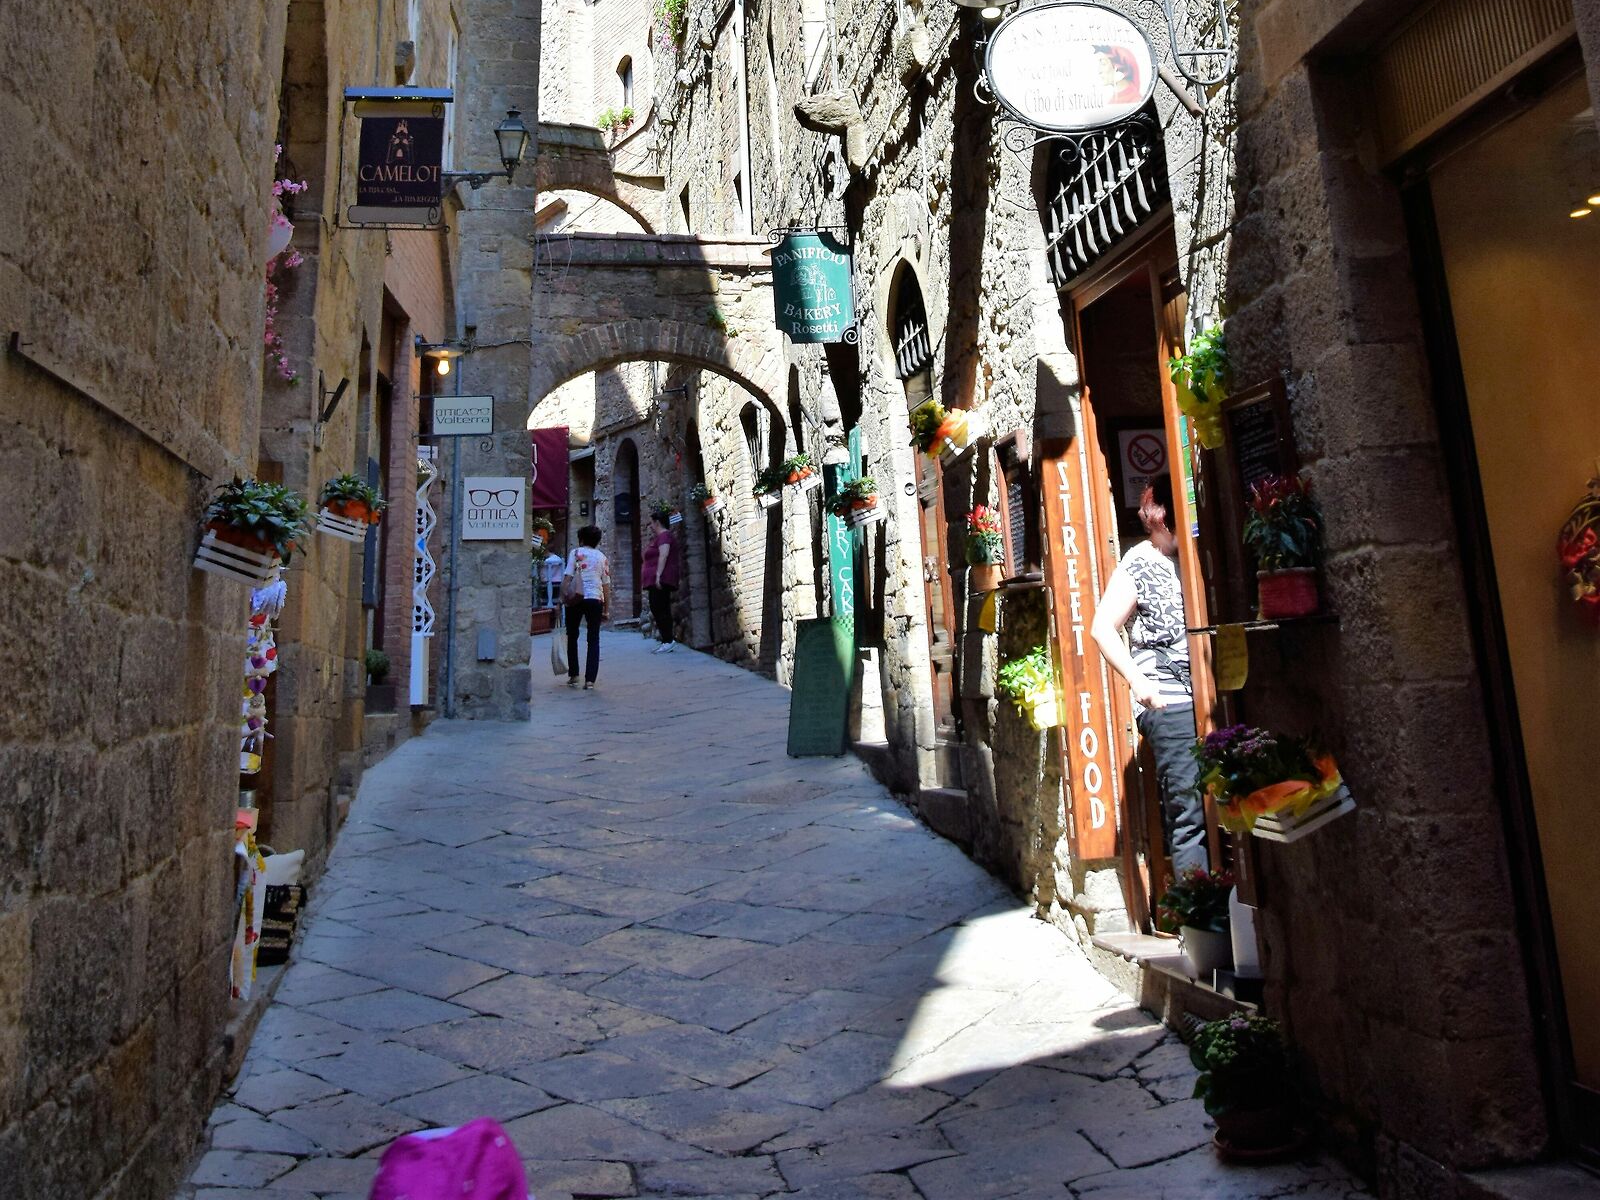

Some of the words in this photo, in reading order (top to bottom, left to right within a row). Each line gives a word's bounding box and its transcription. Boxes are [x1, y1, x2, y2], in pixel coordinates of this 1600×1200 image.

[1024, 87, 1051, 114] Cibo
[1054, 87, 1065, 112] di
[1068, 85, 1104, 111] strada
[360, 164, 441, 182] CAMELOT
[775, 246, 846, 267] PANIFICIO
[783, 302, 842, 320] BAKERY
[791, 320, 839, 335] Rosetti
[435, 408, 470, 417] OTTICA
[436, 416, 490, 424] Volterra
[468, 508, 518, 520] OTTICA
[468, 520, 520, 529] Volterra
[1056, 461, 1085, 656] STREET
[1079, 692, 1106, 830] FOOD
